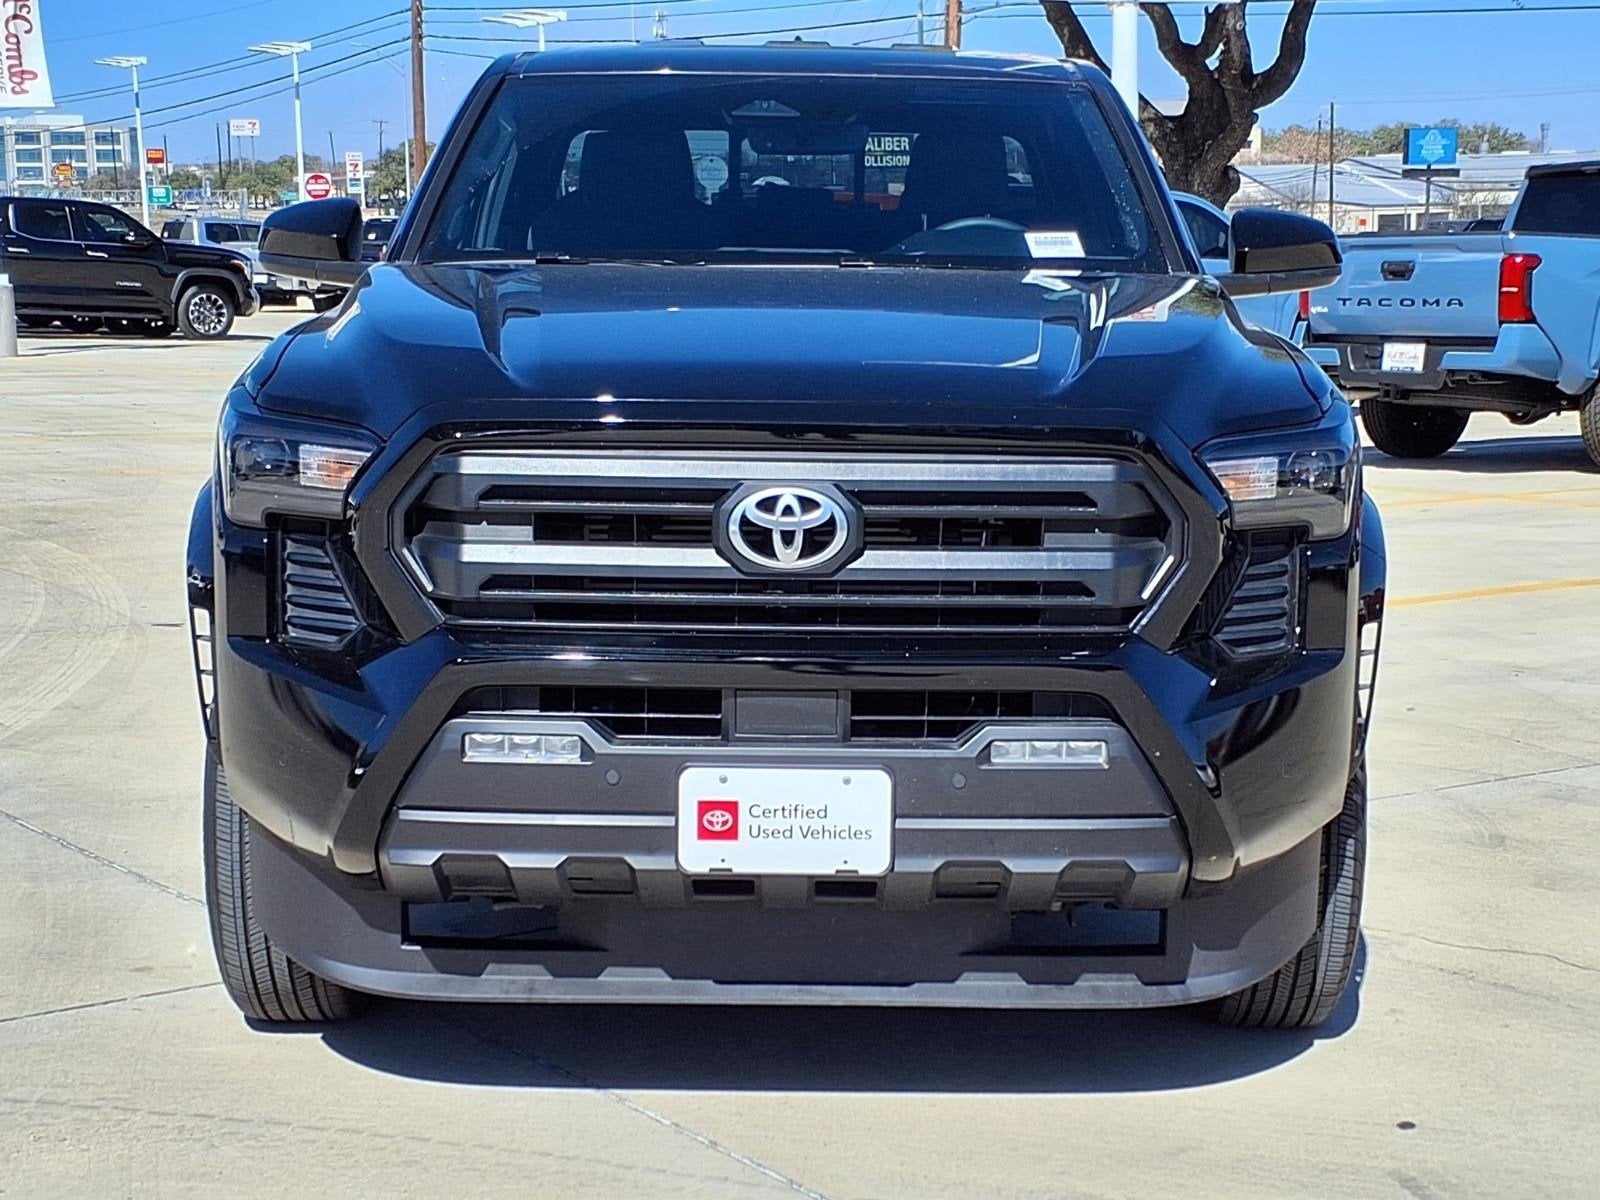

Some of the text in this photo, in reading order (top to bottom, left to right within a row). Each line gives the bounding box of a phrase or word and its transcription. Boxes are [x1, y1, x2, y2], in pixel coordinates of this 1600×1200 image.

[3, 0, 38, 95] cCombs
[865, 137, 909, 151] ALIBER
[864, 155, 910, 167] OLLISION
[1336, 298, 1464, 308] TACOMA
[748, 804, 828, 819] Certified
[748, 824, 873, 841] Used Vehicles
